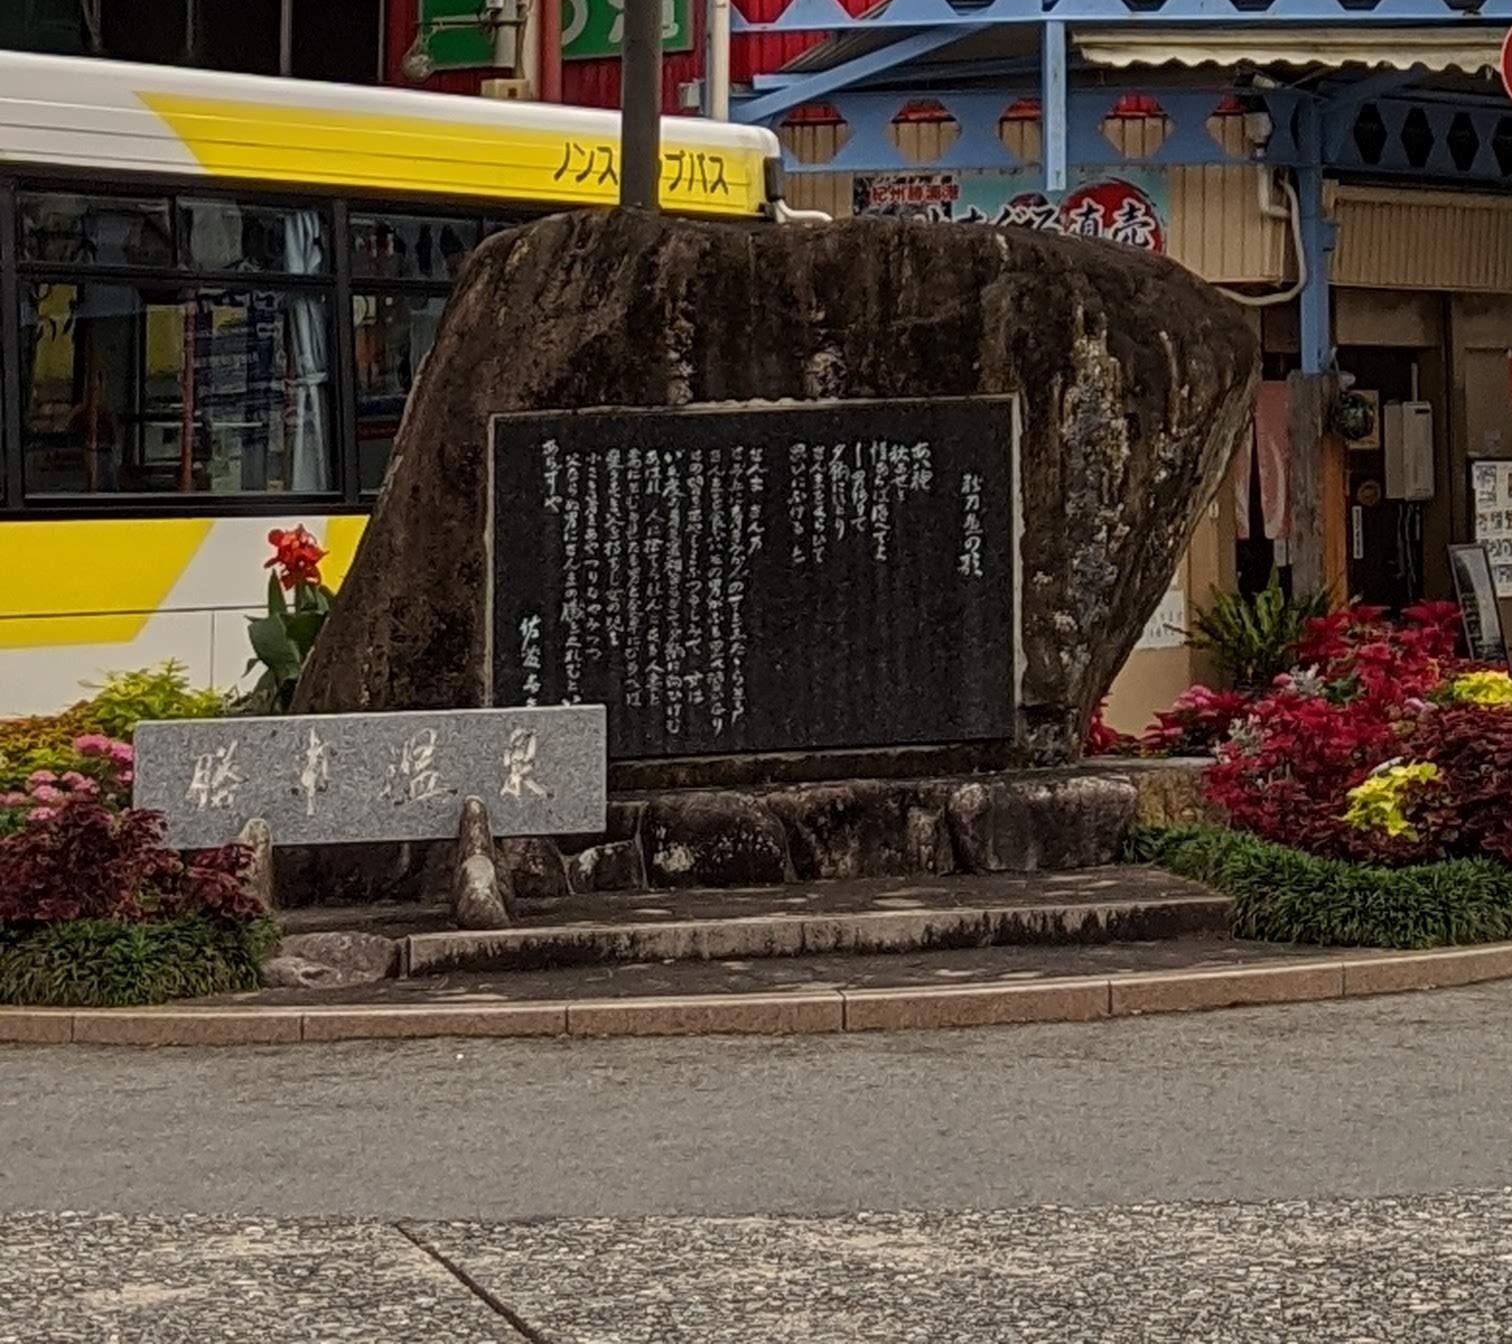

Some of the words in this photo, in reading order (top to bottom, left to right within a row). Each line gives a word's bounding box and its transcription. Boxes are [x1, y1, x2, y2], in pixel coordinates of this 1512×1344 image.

[553, 142, 730, 194] ノンスプバス
